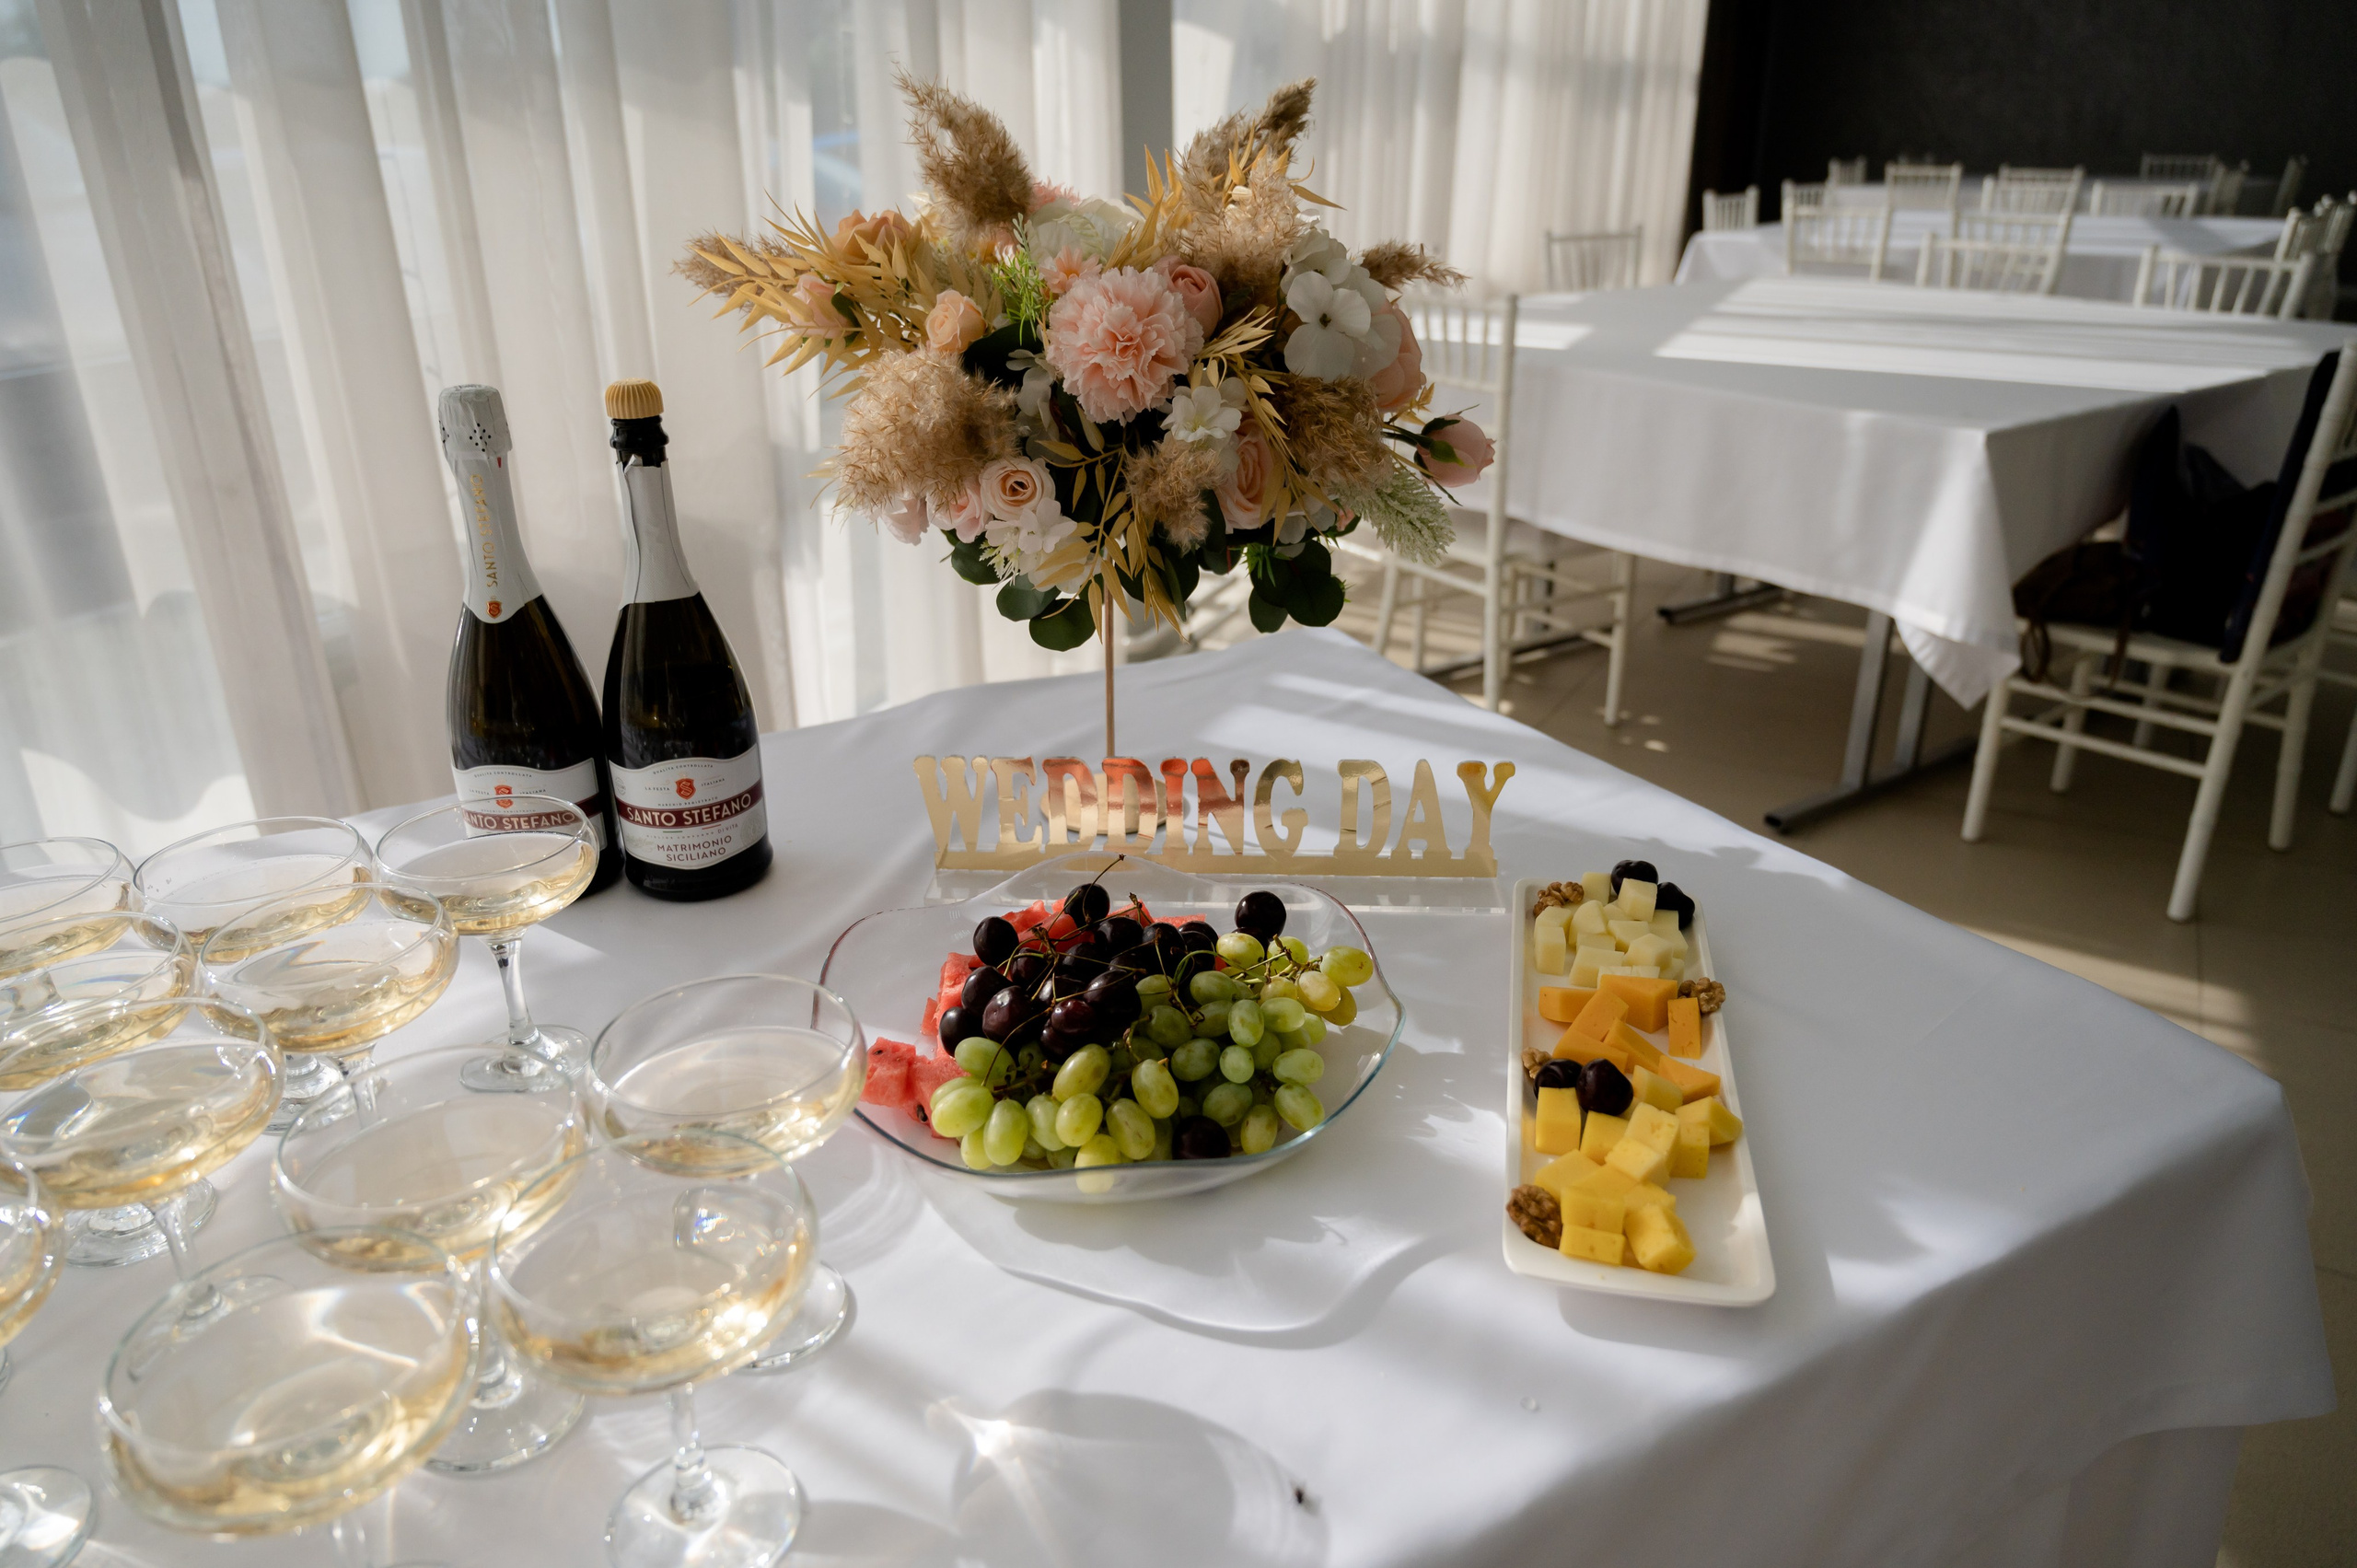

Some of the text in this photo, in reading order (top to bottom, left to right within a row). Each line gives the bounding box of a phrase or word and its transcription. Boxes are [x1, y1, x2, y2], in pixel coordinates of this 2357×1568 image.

[470, 473, 498, 588] SANTO STEFANO
[502, 811, 575, 830] STEFANO
[626, 793, 751, 827] SANTO STEFANO
[912, 755, 1516, 862] WEDDING DAY
[656, 834, 733, 853] MATRIMONIO
[666, 846, 726, 863] SICILIANO
